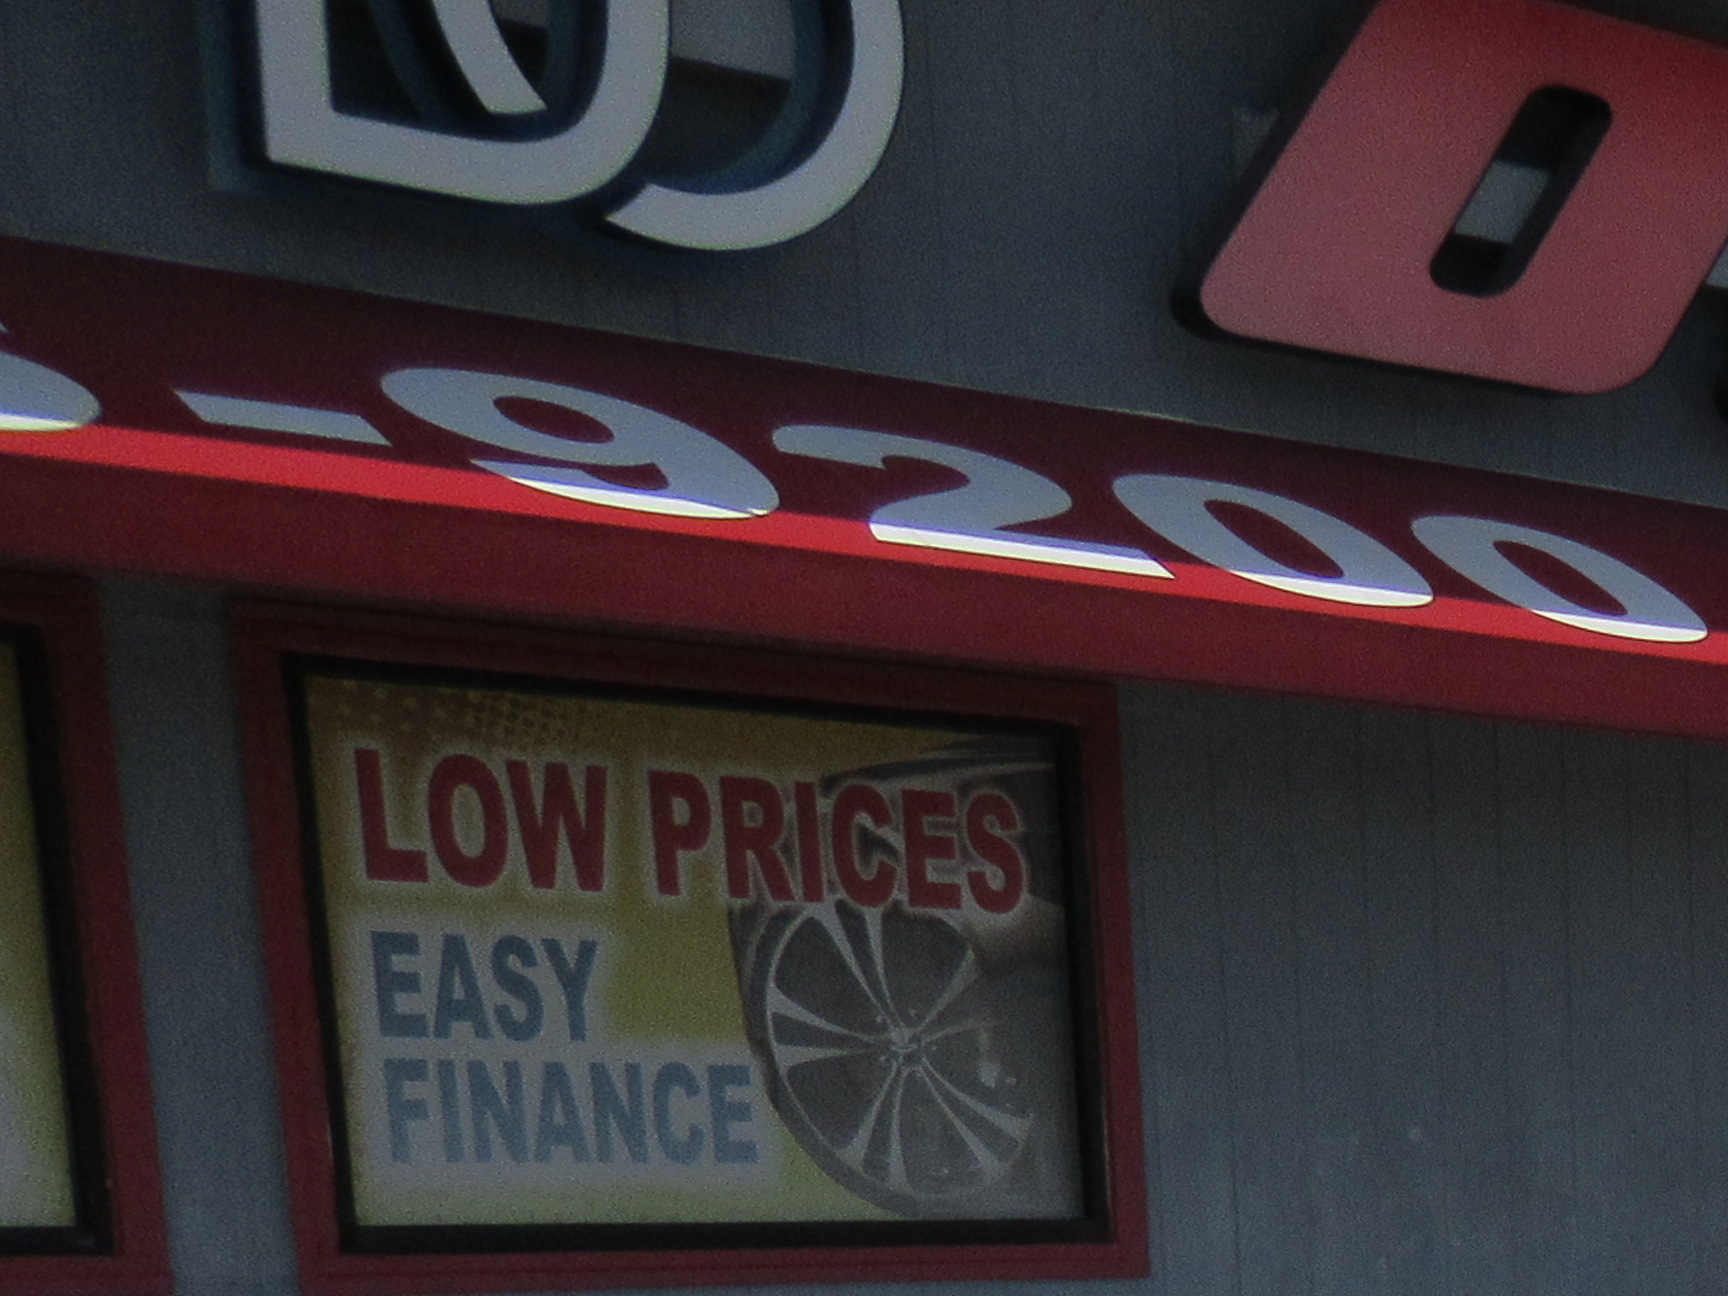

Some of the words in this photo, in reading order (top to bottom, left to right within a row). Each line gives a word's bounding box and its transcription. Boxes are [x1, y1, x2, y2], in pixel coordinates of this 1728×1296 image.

[354, 747, 608, 893] LOW
[646, 767, 1028, 914] PRICES
[370, 930, 599, 1043] EASY
[381, 1058, 760, 1167] FINANCE
